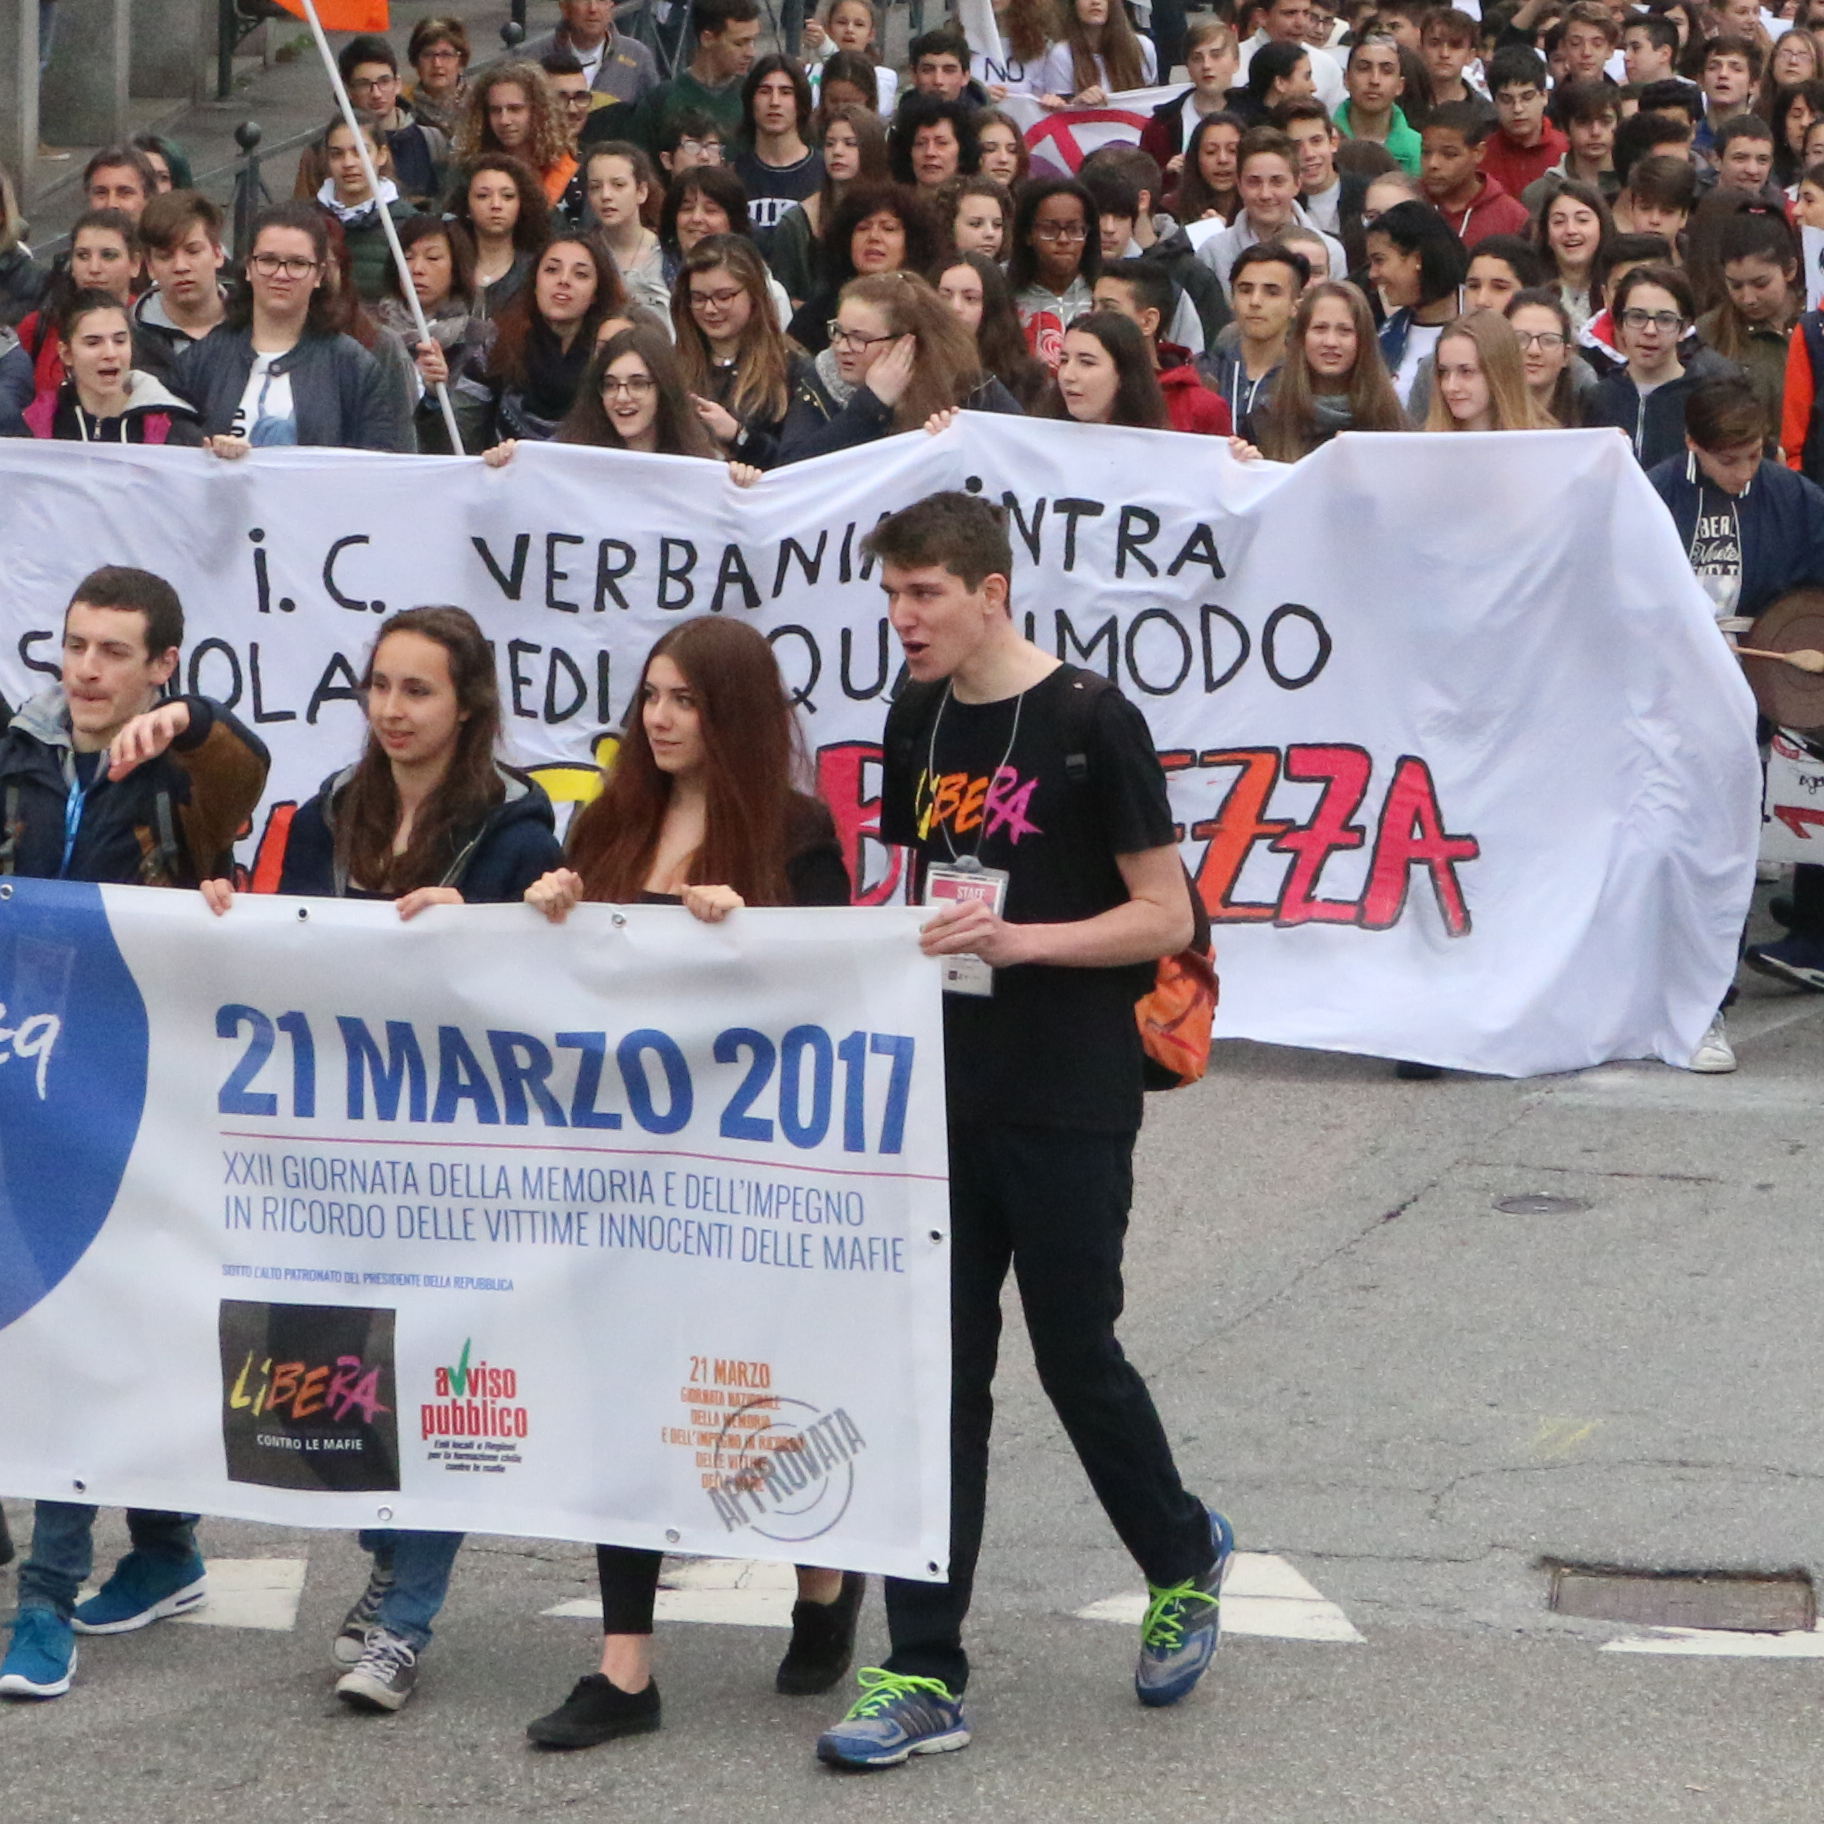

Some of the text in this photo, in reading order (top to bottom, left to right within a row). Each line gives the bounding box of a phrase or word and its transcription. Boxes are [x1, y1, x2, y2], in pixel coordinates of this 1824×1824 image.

[984, 55, 1025, 84] NO
[470, 512, 890, 613] VERBANI
[214, 1002, 915, 1155] 21 MARZO 2017
[223, 1150, 865, 1227] XXII GIORNATA DELLA MEMORIA E DELL'IMPEGNO
[225, 1194, 906, 1274] IN RICORDO DELLE VITTIME INNOCENTI DELLE MAFIE
[221, 1263, 252, 1278] SOTTO
[283, 1267, 343, 1284] PATRONATO
[344, 1270, 361, 1285] DEL
[363, 1271, 422, 1288] PRESIDENTE
[423, 1274, 451, 1289] DELLA
[452, 1275, 515, 1292] REPUBBLICA
[434, 1340, 518, 1399] avviso
[689, 1355, 772, 1390] 21 MARZO
[256, 1433, 364, 1452] CONTRO LE MAFIE
[420, 1397, 530, 1441] pubblico
[706, 1406, 867, 1534] APPROVATA
